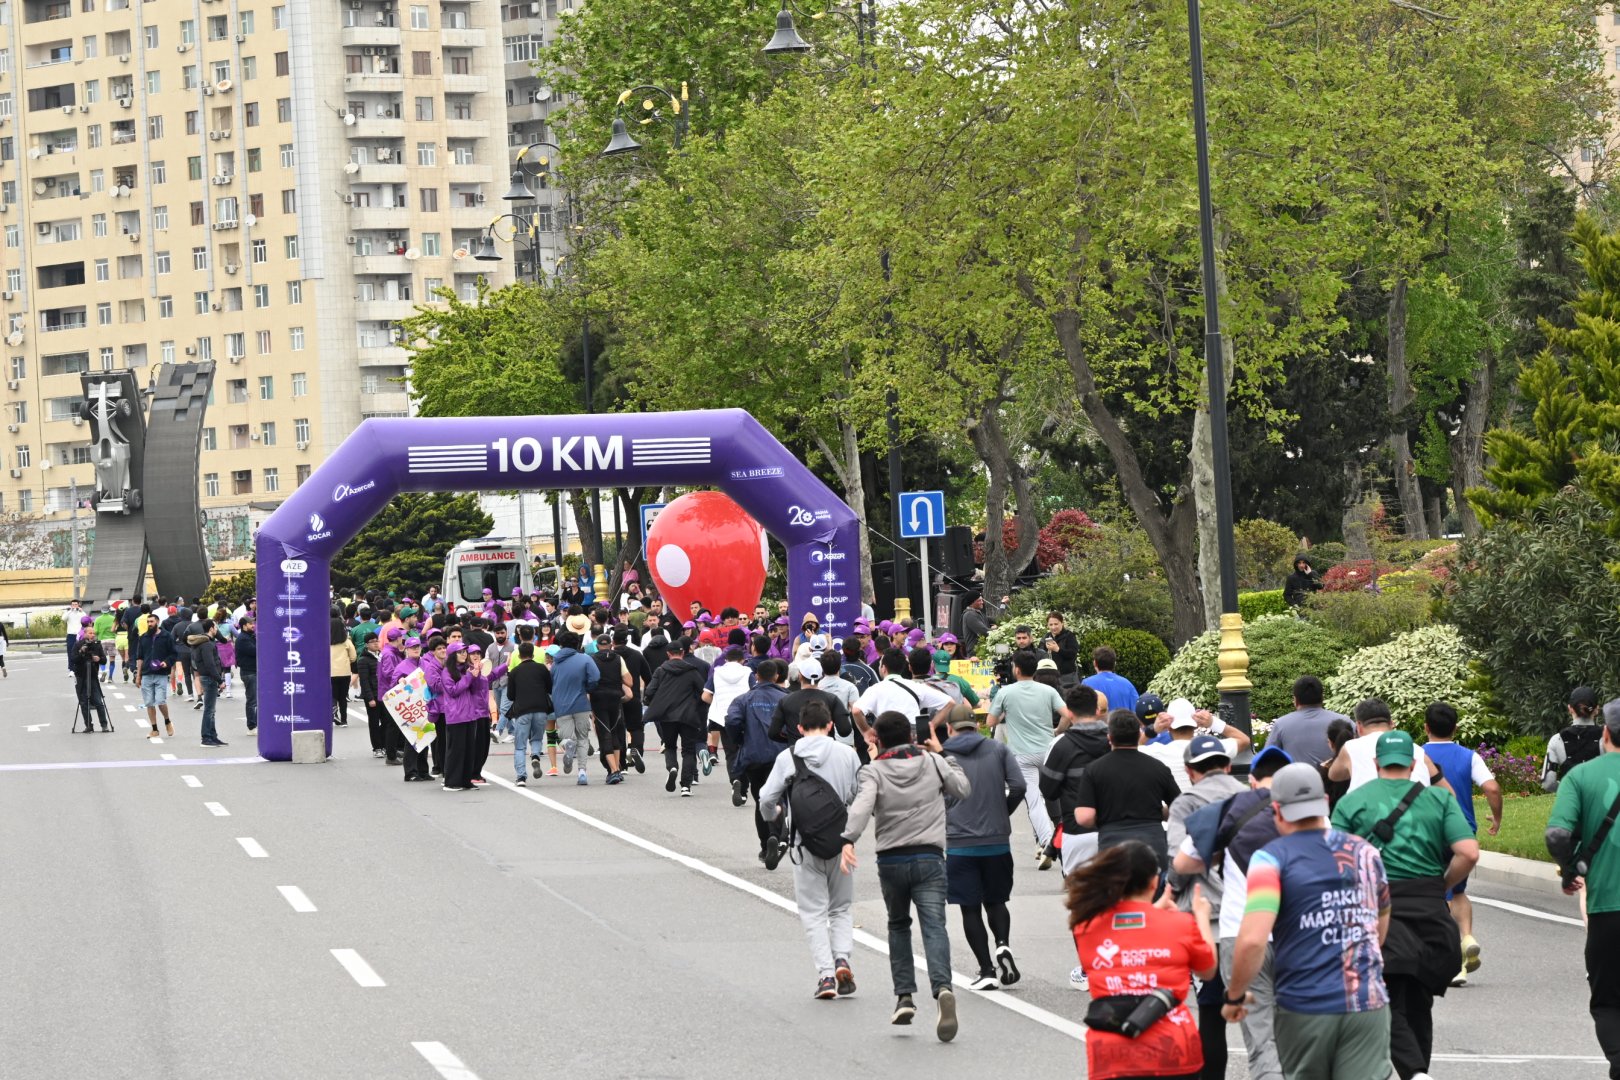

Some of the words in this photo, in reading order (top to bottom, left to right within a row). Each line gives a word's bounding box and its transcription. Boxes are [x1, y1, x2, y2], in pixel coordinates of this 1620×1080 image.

[491, 437, 543, 472] 10
[552, 435, 624, 471] KM
[749, 467, 783, 477] BREEZE
[349, 481, 375, 495] Azercell
[308, 531, 331, 541] SOCAR
[460, 552, 516, 562] AMBULANCE
[394, 702, 417, 723] STOP
[408, 703, 425, 720] NOT
[415, 700, 429, 712] DO
[1321, 890, 1362, 908] BAKU
[1321, 926, 1362, 945] CLUB
[1121, 948, 1171, 960] DOCTOR
[1121, 957, 1146, 967] RUN
